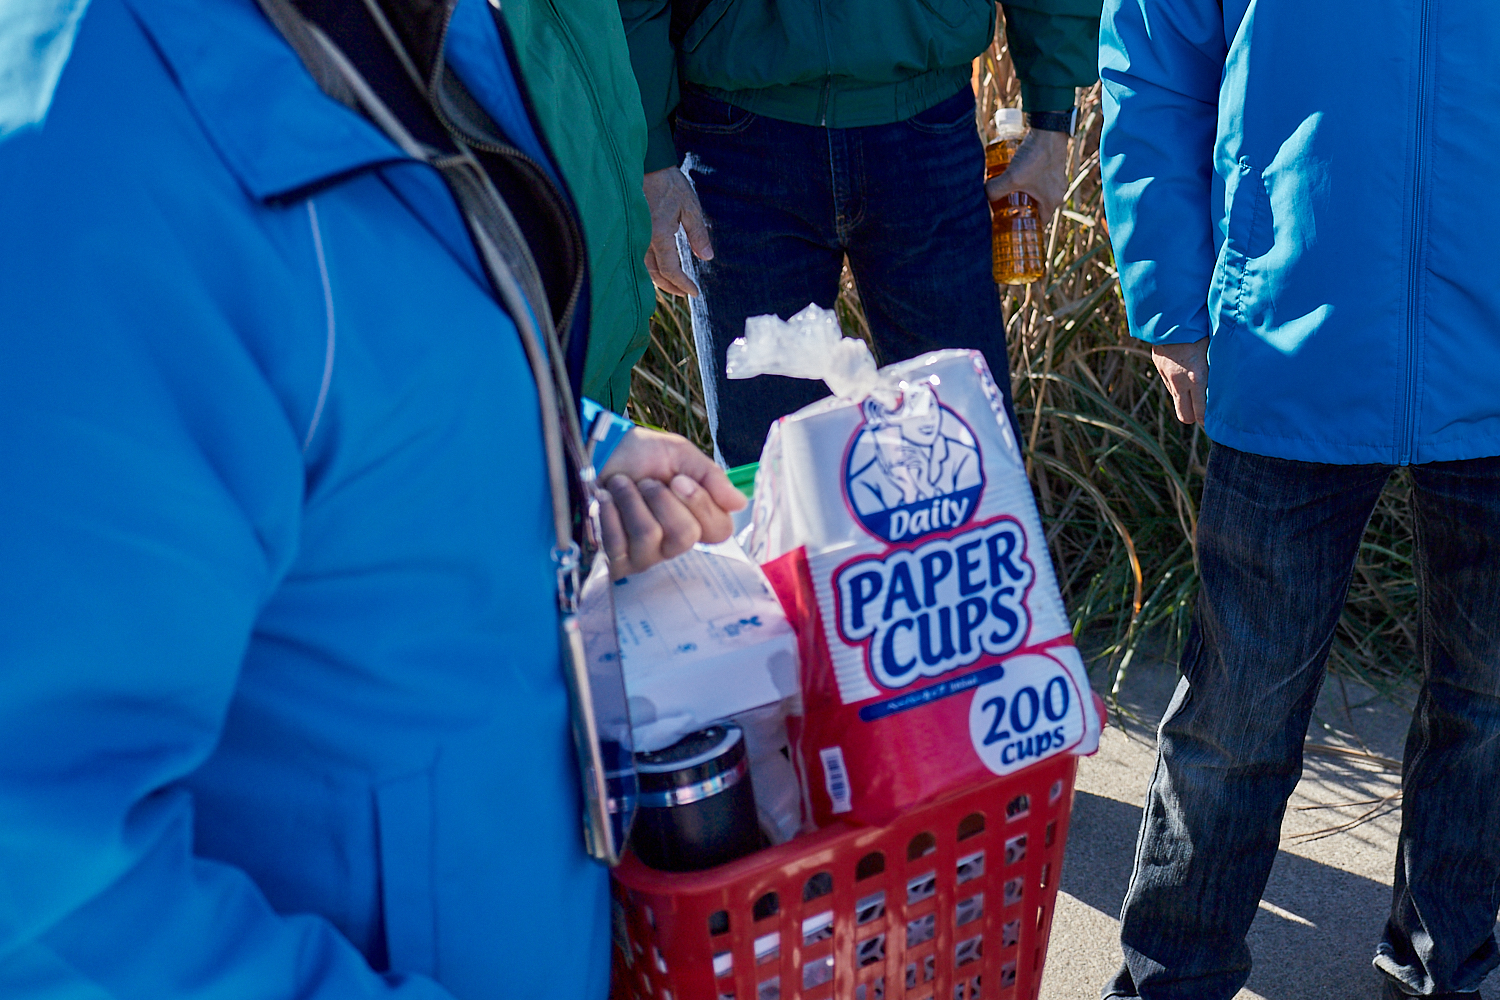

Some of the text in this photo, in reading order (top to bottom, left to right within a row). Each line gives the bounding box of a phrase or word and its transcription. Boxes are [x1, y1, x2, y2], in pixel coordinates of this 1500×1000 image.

[889, 496, 970, 541] Daily
[848, 531, 1024, 632] PAPER
[881, 586, 1019, 677] CUPS
[980, 675, 1071, 747] 200
[1000, 723, 1066, 768] cups
